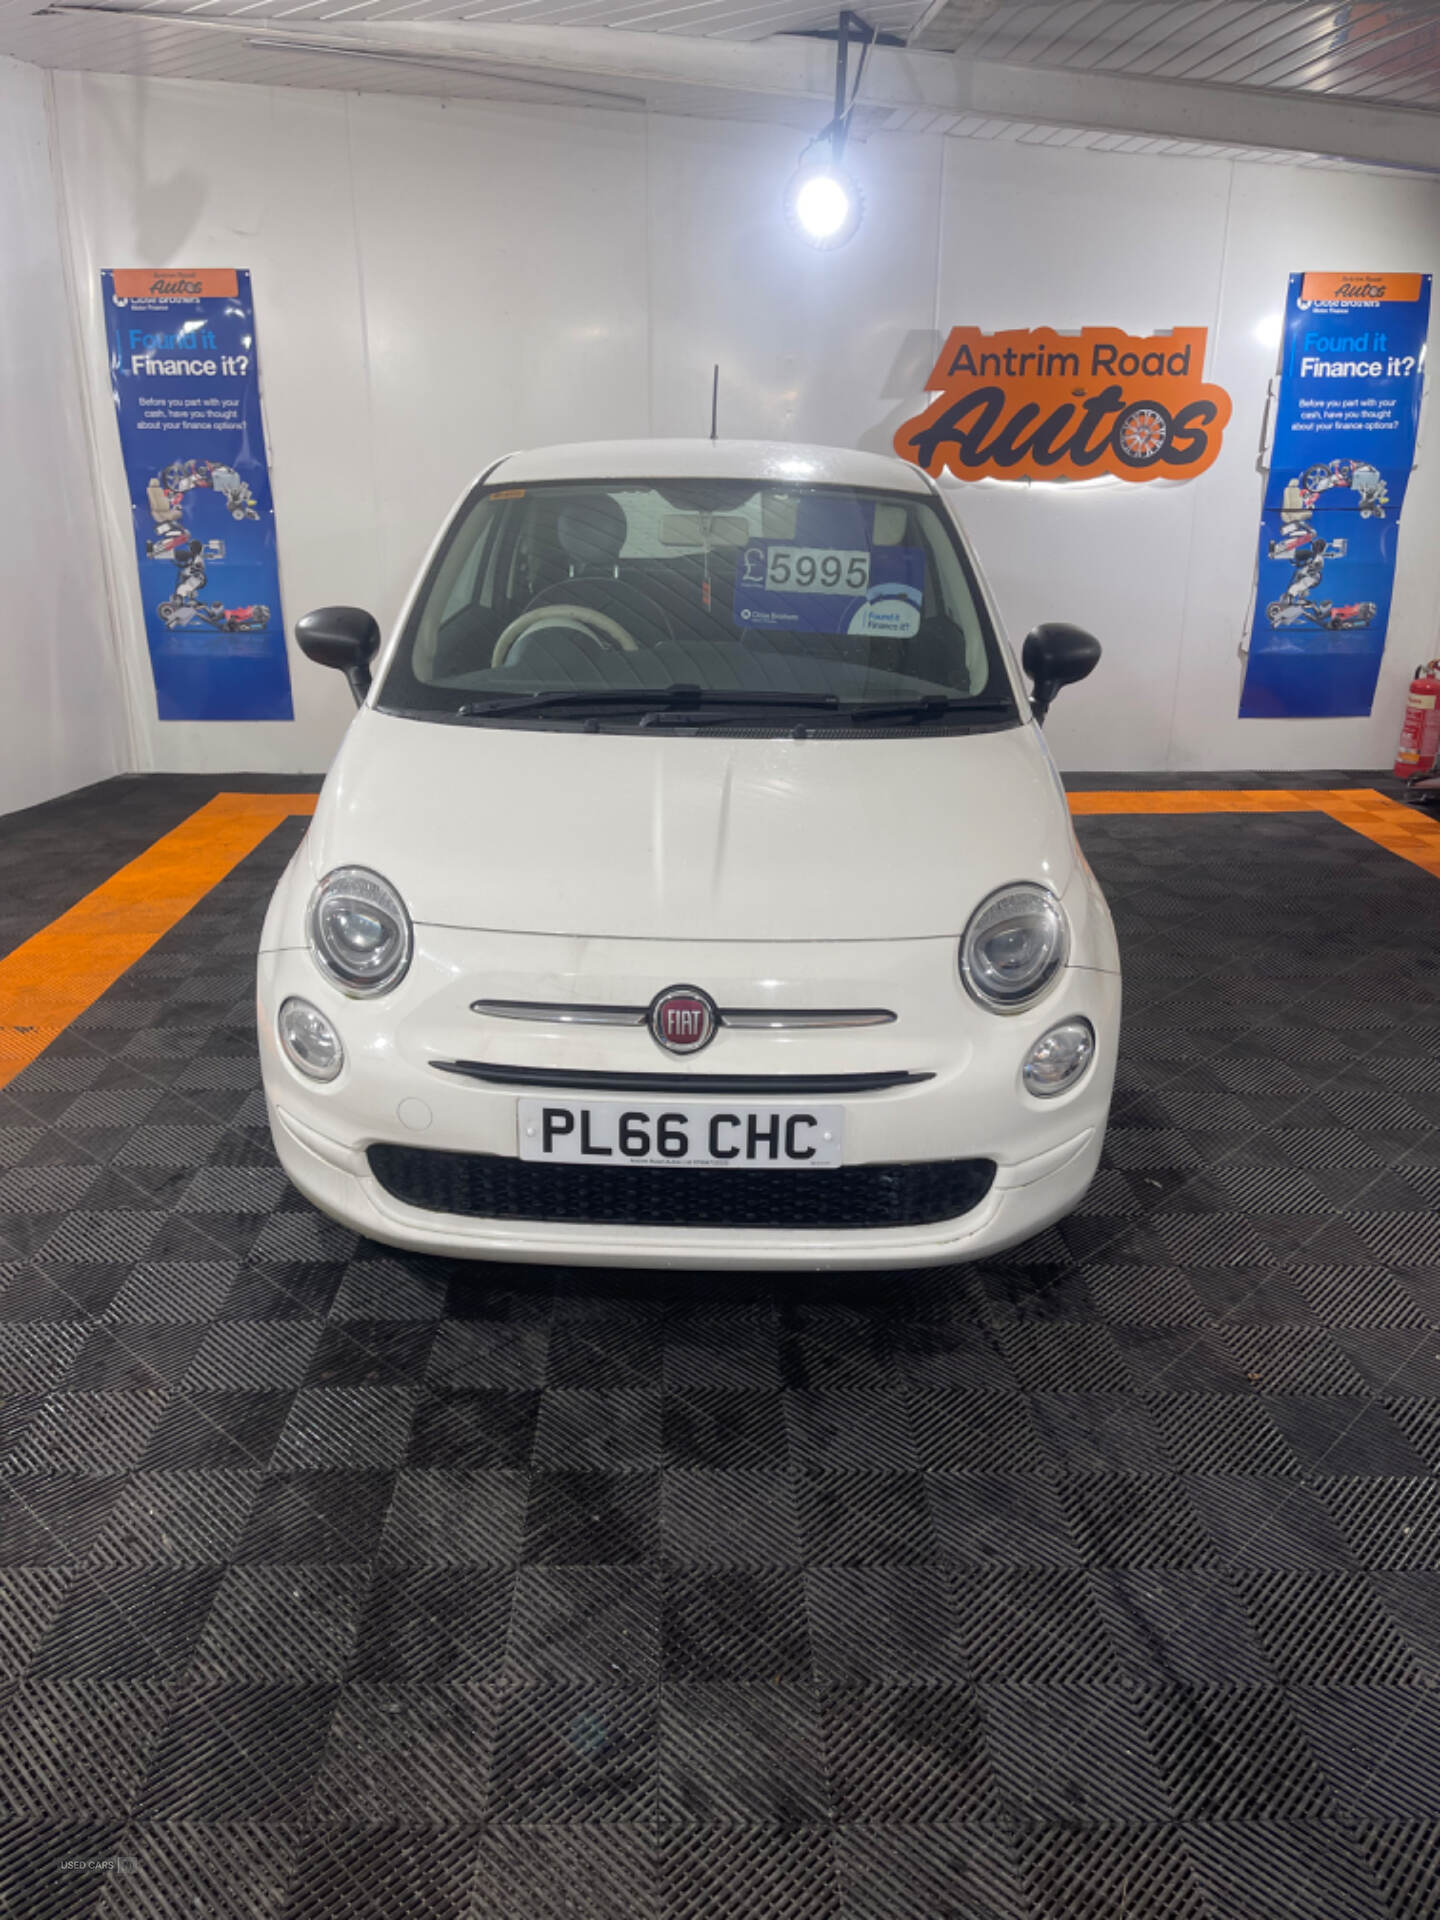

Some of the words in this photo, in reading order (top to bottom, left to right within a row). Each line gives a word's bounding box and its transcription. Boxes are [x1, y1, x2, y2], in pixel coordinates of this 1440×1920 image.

[149, 279, 203, 295] Autos
[1334, 283, 1387, 298] Autos
[128, 329, 197, 350] Found
[202, 330, 217, 350] it
[1304, 332, 1369, 352] Found
[1373, 332, 1387, 352] it
[131, 355, 217, 376] Finance
[221, 355, 249, 376] it?
[947, 344, 1080, 377] Antrim
[1091, 344, 1191, 377] Road
[1301, 357, 1382, 377] Finance
[1387, 356, 1415, 377] it?
[139, 397, 166, 407] Before
[167, 399, 184, 408] you
[184, 398, 201, 408] part
[203, 397, 220, 407] with
[221, 399, 240, 408] your
[1298, 398, 1325, 408] Before
[1326, 400, 1341, 409] you
[1342, 399, 1359, 408] part
[1360, 398, 1377, 407] with
[1378, 399, 1397, 409] your
[168, 409, 188, 418] have
[190, 410, 205, 419] you
[207, 409, 237, 420] thought
[1323, 410, 1343, 419] have
[1344, 411, 1359, 421] you
[1361, 409, 1391, 420] thought
[136, 420, 160, 429] about
[161, 421, 180, 431] your
[182, 420, 212, 430] finance
[908, 385, 1218, 468] Autos
[1291, 422, 1314, 431] about
[1315, 422, 1333, 433] your
[1334, 420, 1362, 430] finance
[1364, 420, 1399, 432] options?
[868, 620, 898, 631] Finance
[667, 1009, 702, 1036] FIAT
[542, 1108, 689, 1159] PL66
[708, 1113, 818, 1160] CHC
